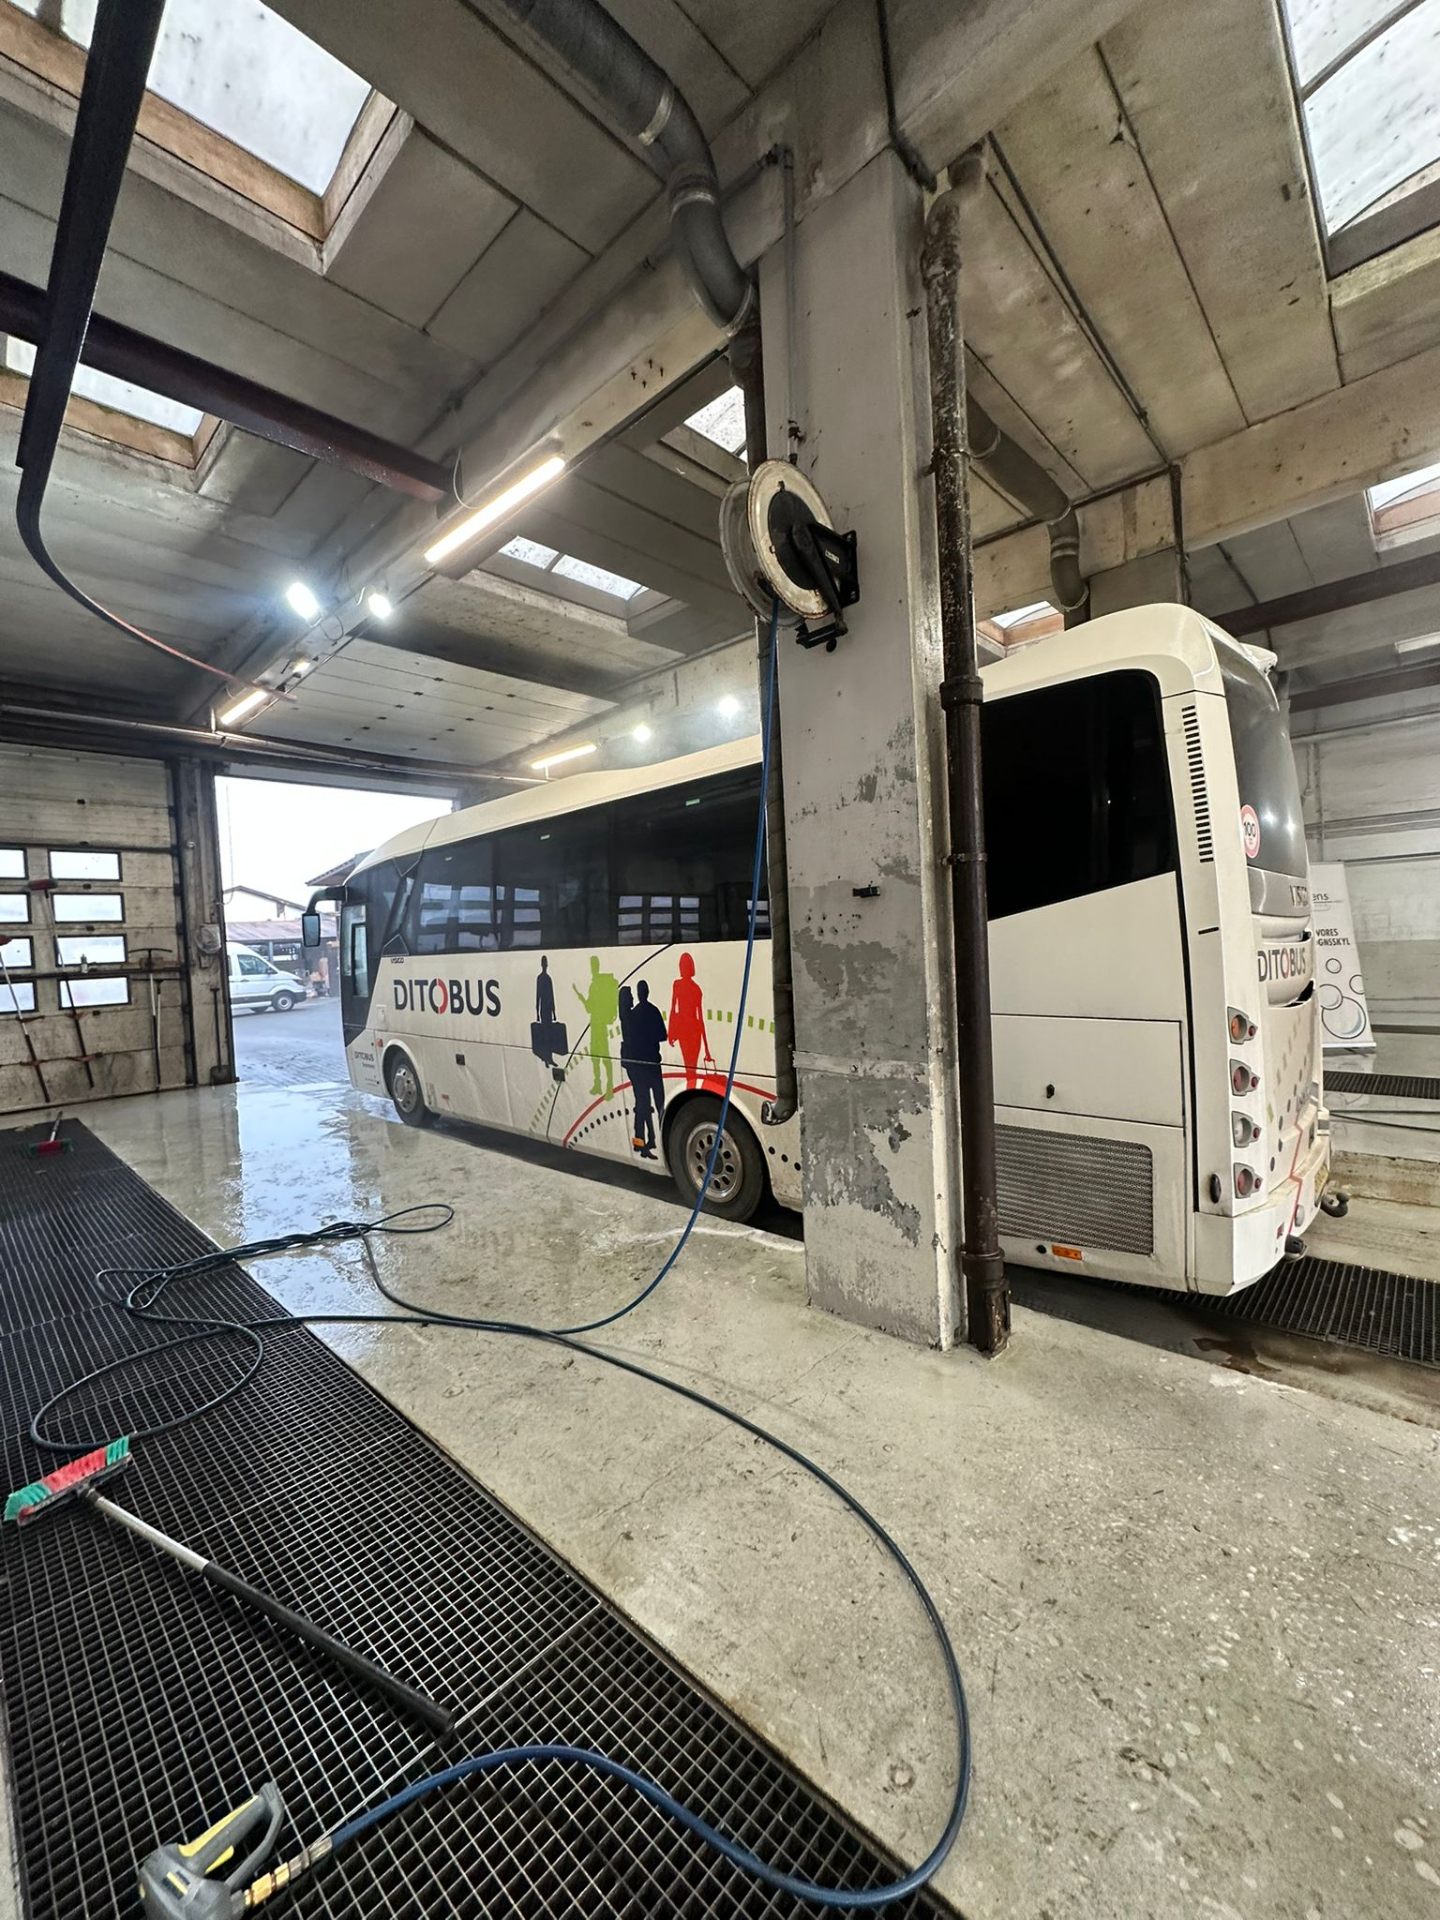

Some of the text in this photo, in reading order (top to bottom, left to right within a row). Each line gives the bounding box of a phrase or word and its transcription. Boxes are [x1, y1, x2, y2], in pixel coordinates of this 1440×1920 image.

[1243, 821, 1257, 838] 100
[1315, 928, 1339, 937] VORES
[1317, 937, 1351, 946] GNSSKYL
[1257, 947, 1306, 982] DITOBUS
[393, 978, 501, 1017] DITOBUS
